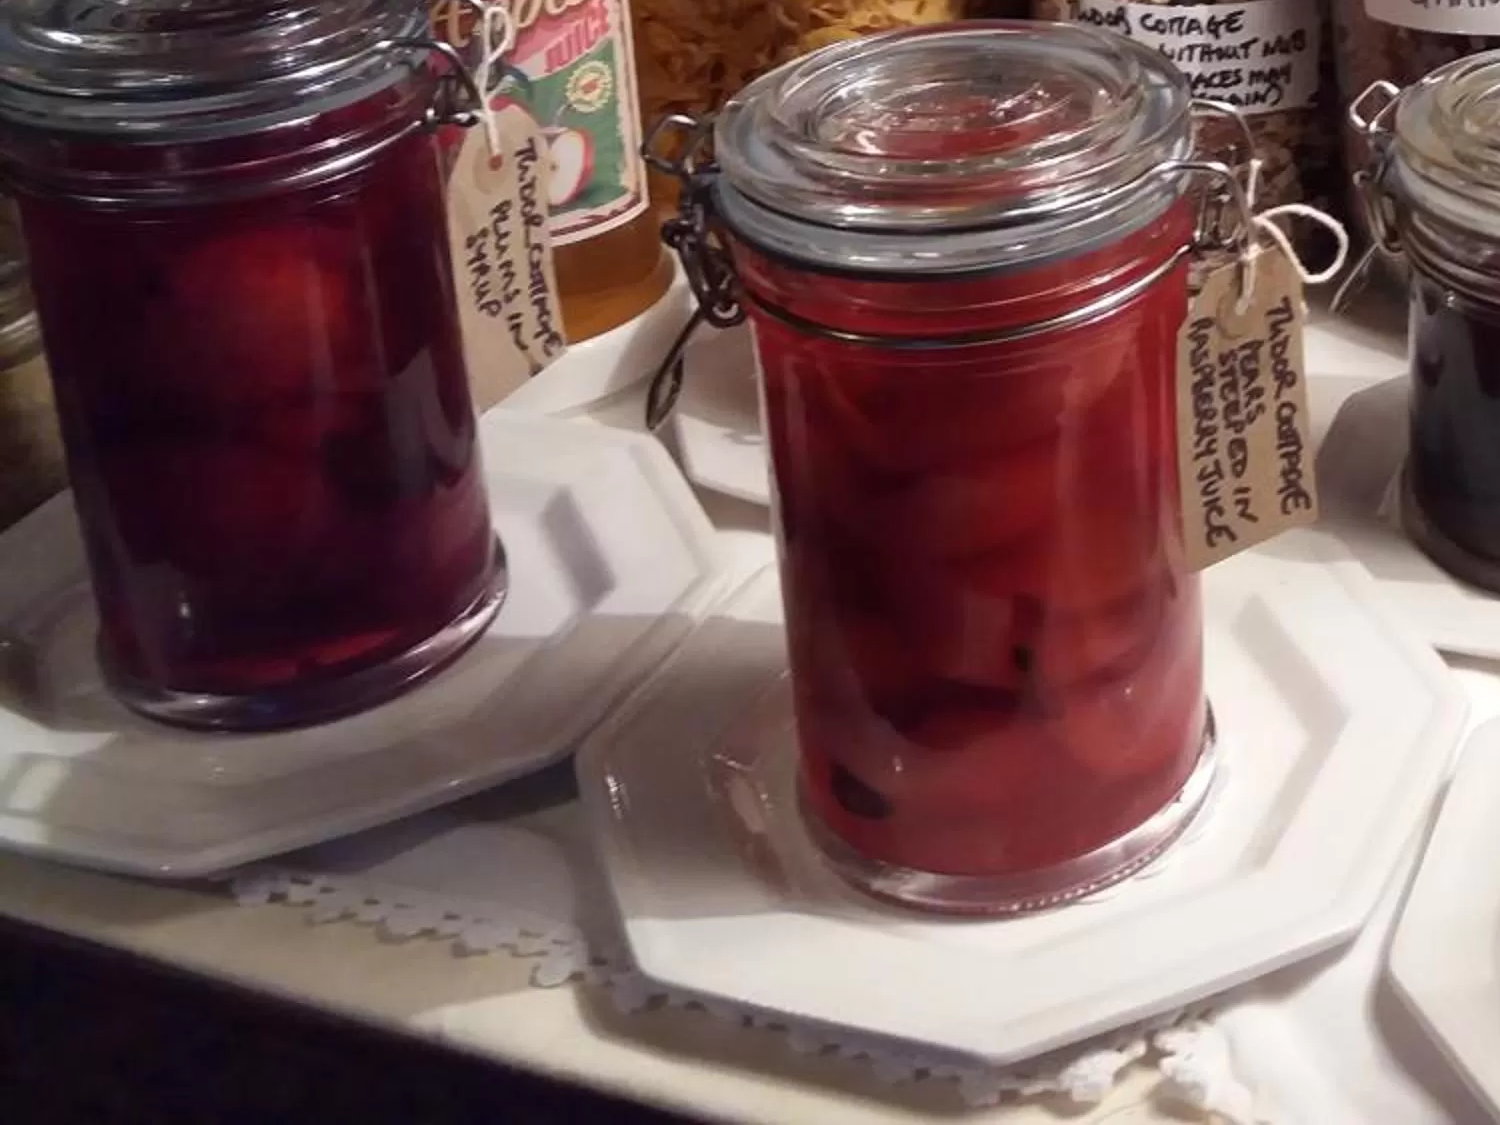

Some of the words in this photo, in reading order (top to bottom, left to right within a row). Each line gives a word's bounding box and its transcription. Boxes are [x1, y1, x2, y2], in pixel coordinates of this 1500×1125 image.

[1139, 9, 1246, 40] COTTAGE
[464, 226, 502, 317] SYRUP
[489, 198, 521, 305] PLUMS
[1186, 316, 1218, 461] RASPBERRY
[1238, 338, 1266, 426] PEARS
[1265, 295, 1297, 400] TUDOR
[1218, 349, 1249, 479] STEEPED
[1196, 458, 1238, 549] JUICE
[1231, 486, 1258, 524] IN
